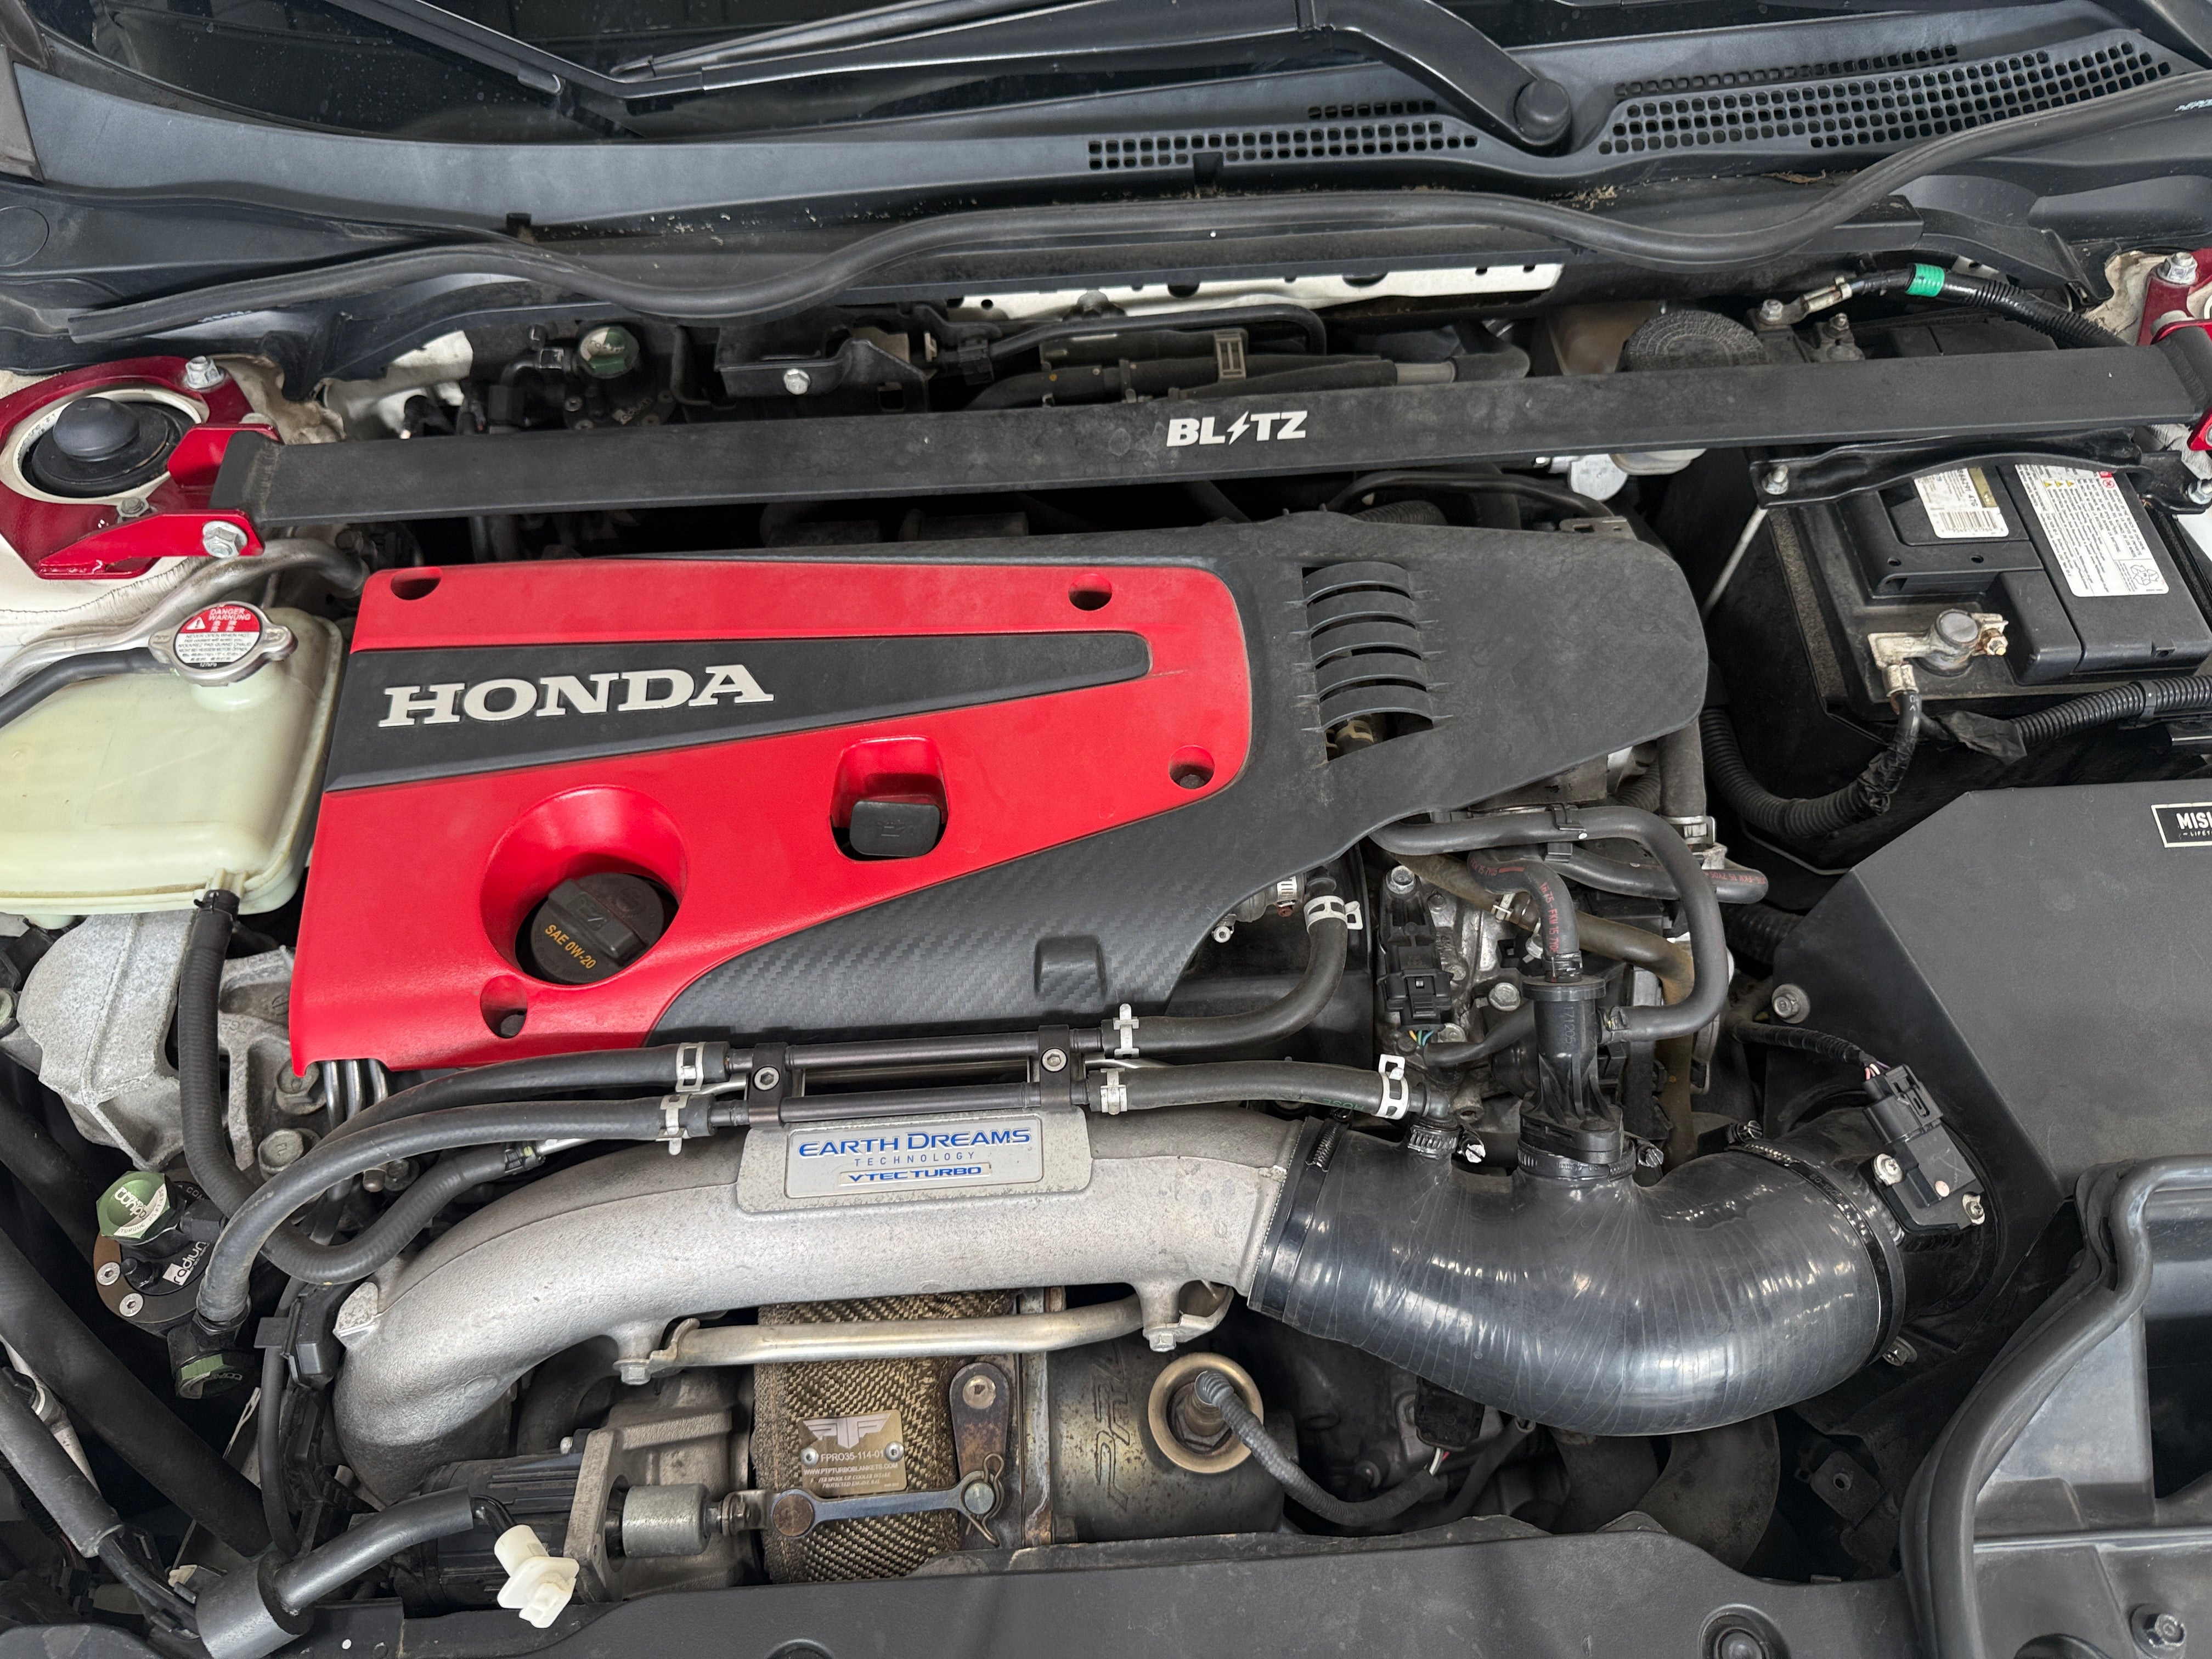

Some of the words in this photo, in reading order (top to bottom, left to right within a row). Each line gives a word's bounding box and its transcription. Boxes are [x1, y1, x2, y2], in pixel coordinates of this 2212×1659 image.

[1166, 410, 1308, 447] BLITZ
[378, 664, 775, 727] HONDA
[545, 923, 570, 946] SAE
[564, 941, 597, 969] 0W-20
[1562, 1006, 1576, 1045] 171205
[799, 1136, 899, 1158] EARTH
[906, 1127, 1031, 1152] DREAMS
[854, 1151, 975, 1167] TECHNOLOGY
[848, 1169, 910, 1182] VTEC
[913, 1165, 982, 1179] TURBO
[803, 1462, 898, 1475] WWW.PTPTURBOBLANKETS.COM
